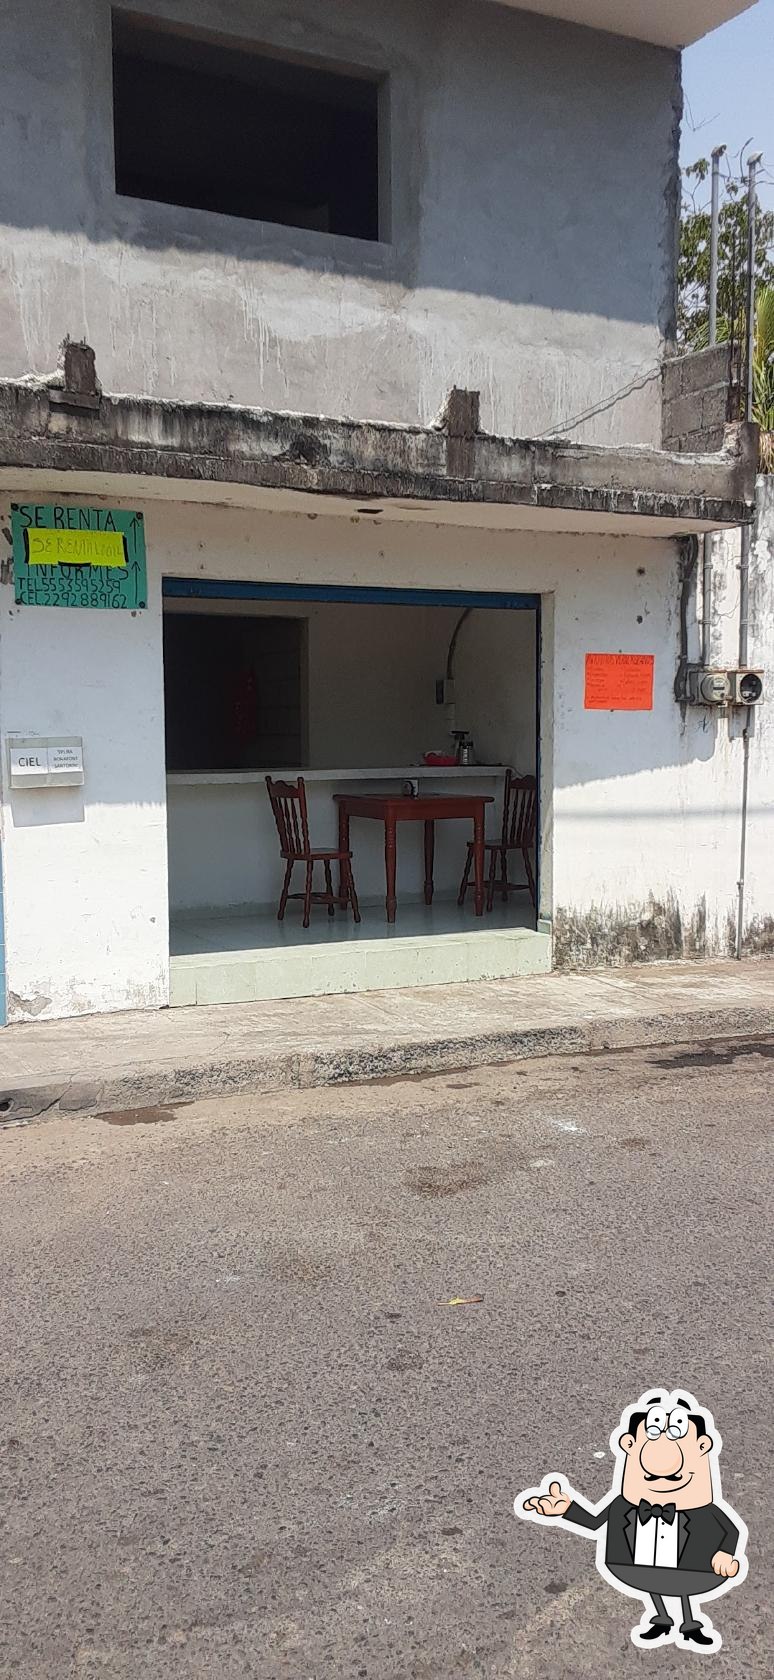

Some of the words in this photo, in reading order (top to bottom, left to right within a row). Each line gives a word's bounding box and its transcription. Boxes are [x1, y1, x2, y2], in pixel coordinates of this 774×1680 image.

[19, 505, 47, 528] SE
[53, 506, 117, 532] RENTA
[31, 537, 52, 553] SE
[27, 563, 129, 581] INFORMES
[18, 757, 41, 767] CIEL
